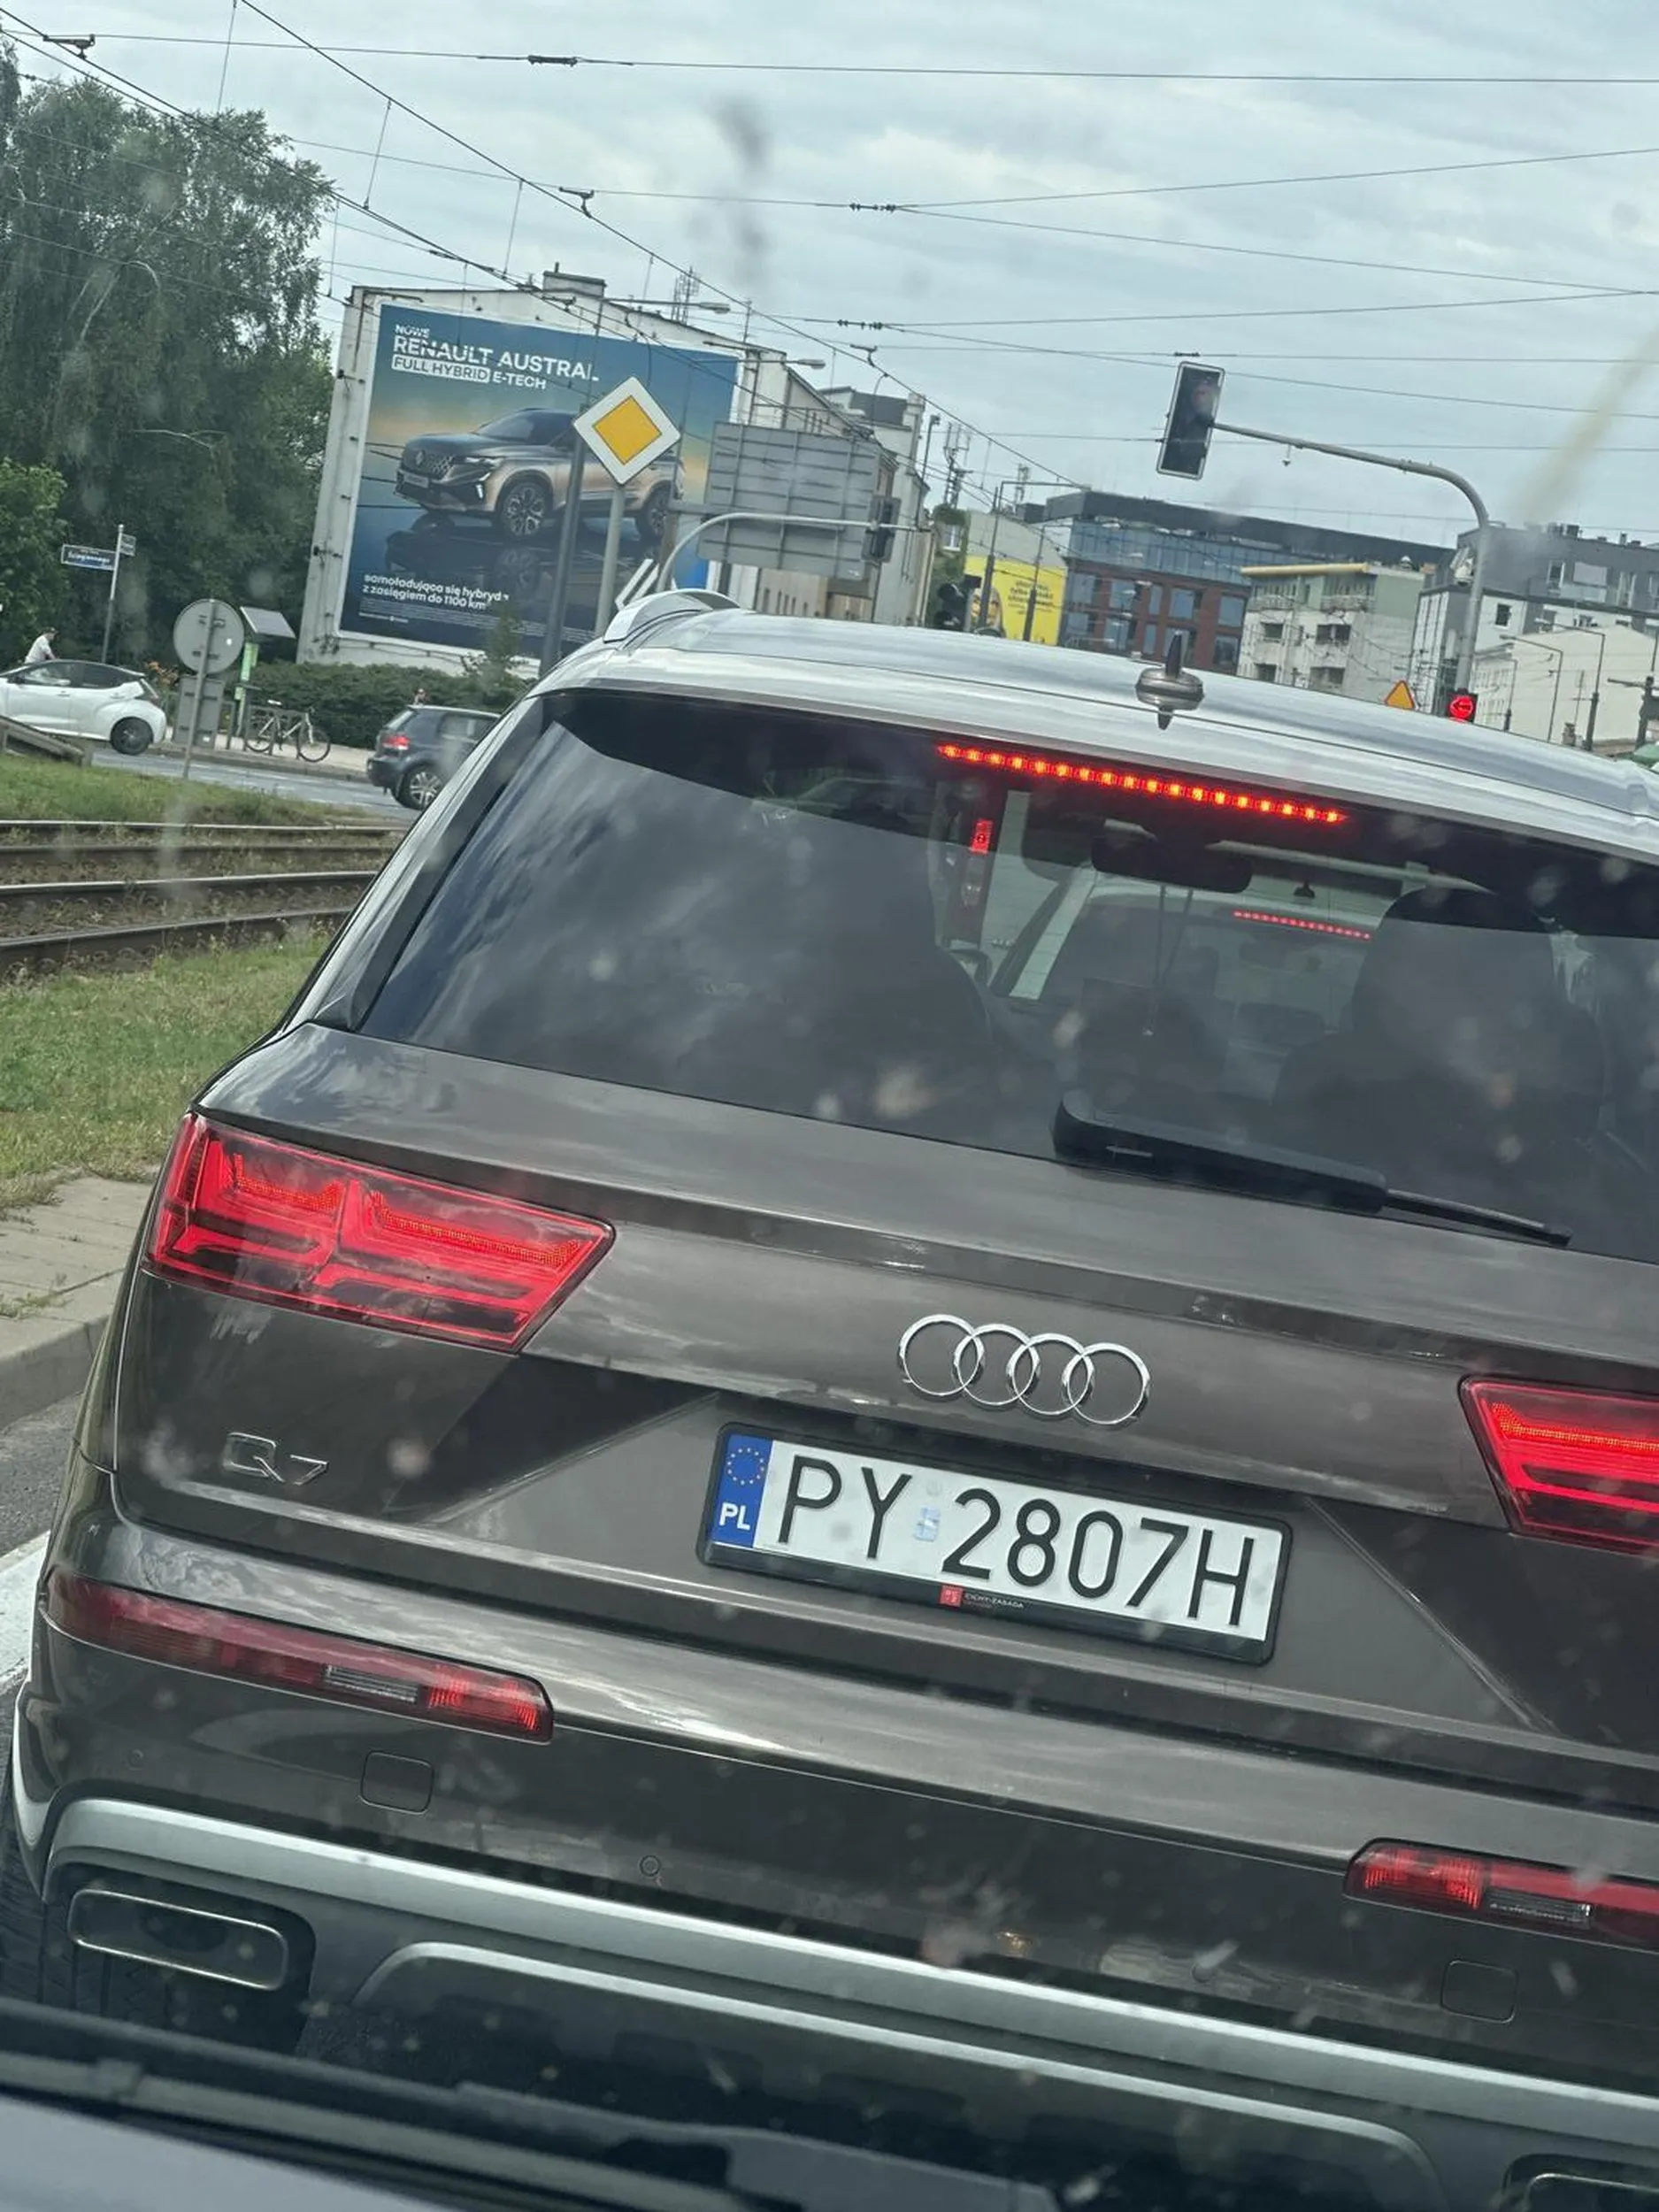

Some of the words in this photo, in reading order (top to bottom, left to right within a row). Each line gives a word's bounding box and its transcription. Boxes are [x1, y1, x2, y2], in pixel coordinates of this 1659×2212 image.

[395, 324, 431, 339] NOWE
[393, 334, 494, 365] RENAULT
[394, 357, 429, 373] FULL
[432, 361, 488, 381] HYBRID
[492, 371, 547, 390] E-TECH
[362, 585, 370, 594] z
[371, 586, 426, 602] zasięgiem
[427, 593, 442, 603] do
[444, 595, 467, 608] 1100
[445, 584, 461, 596] się
[223, 1432, 329, 1486] Q7
[718, 1502, 750, 1531] PL
[779, 1454, 912, 1560] PY
[941, 1487, 1255, 1626] 2807H
